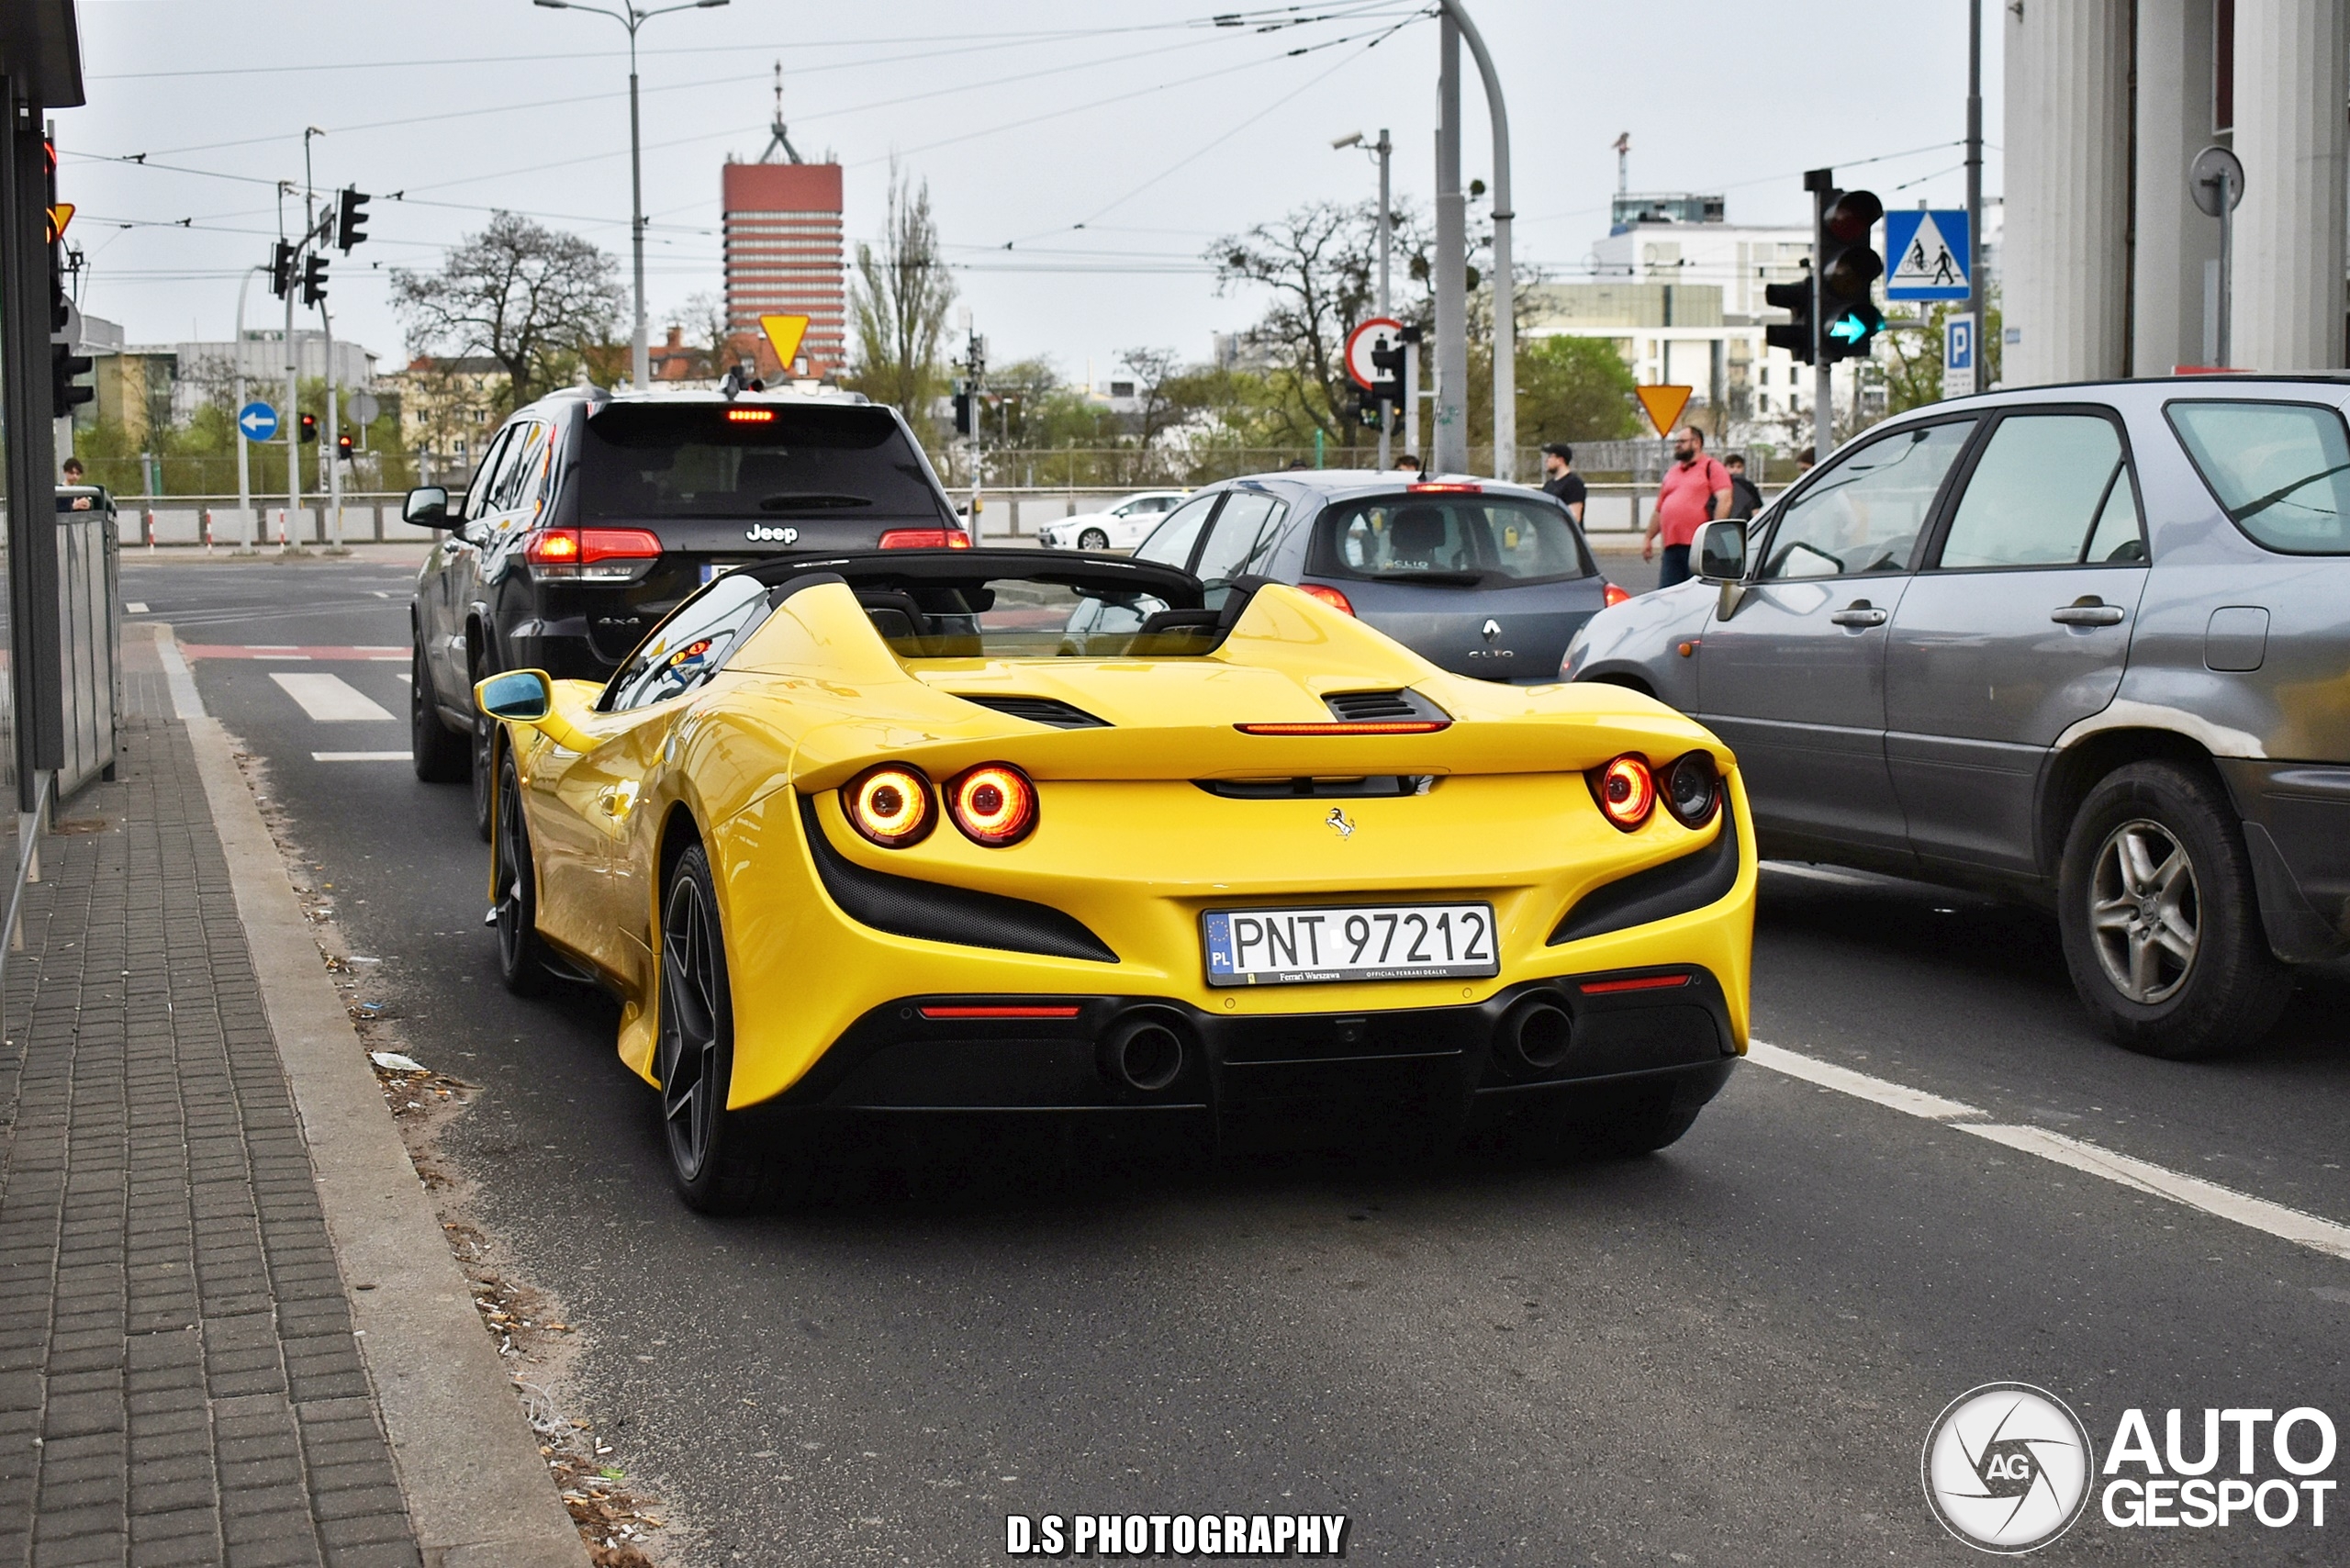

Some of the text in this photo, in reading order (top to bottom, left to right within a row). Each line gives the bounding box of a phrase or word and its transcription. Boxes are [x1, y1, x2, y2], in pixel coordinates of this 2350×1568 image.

[1953, 327, 1967, 364] P
[745, 522, 799, 545] Jeep
[1468, 650, 1514, 658] CLIO
[1234, 912, 1488, 968] PNT 97212
[1212, 951, 1231, 966] PL
[1279, 971, 1340, 981] Ferrari Warszawa
